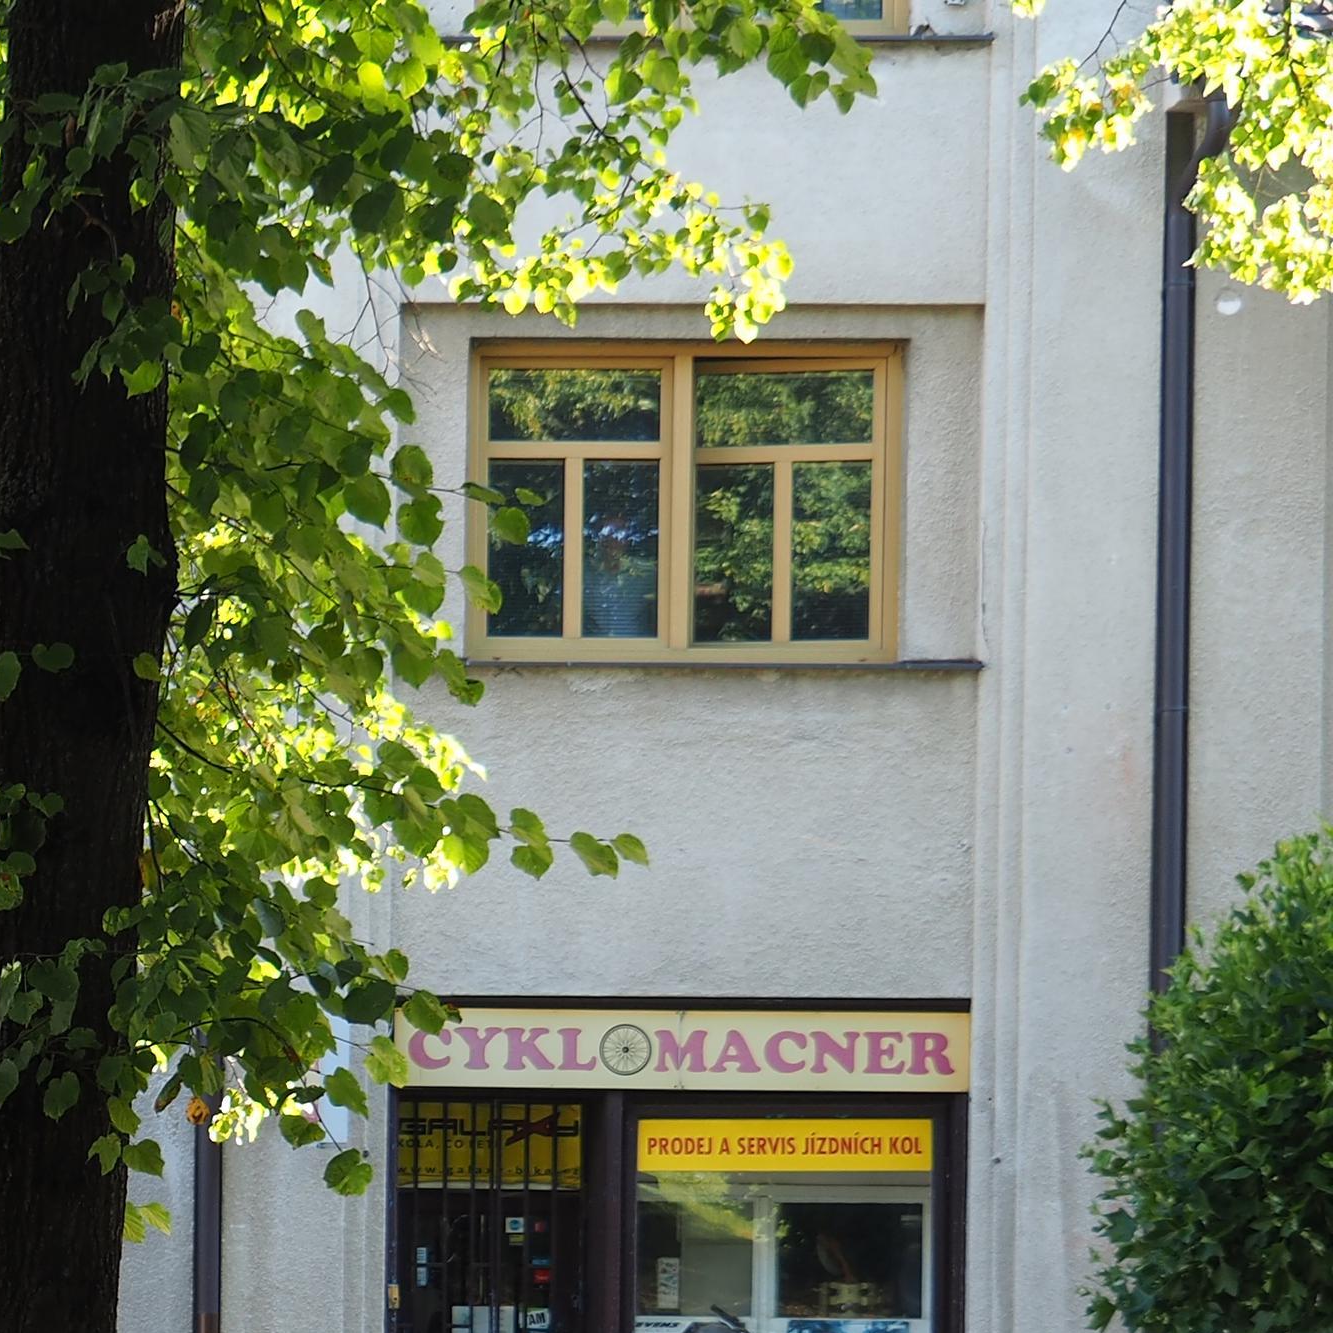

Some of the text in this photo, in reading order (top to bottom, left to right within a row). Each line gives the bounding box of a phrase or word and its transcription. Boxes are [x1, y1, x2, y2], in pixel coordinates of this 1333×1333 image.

[653, 1029, 955, 1076] MACNER
[646, 1132, 923, 1155] PRODEJ A SERVIS JÍZDNÍCH KOL
